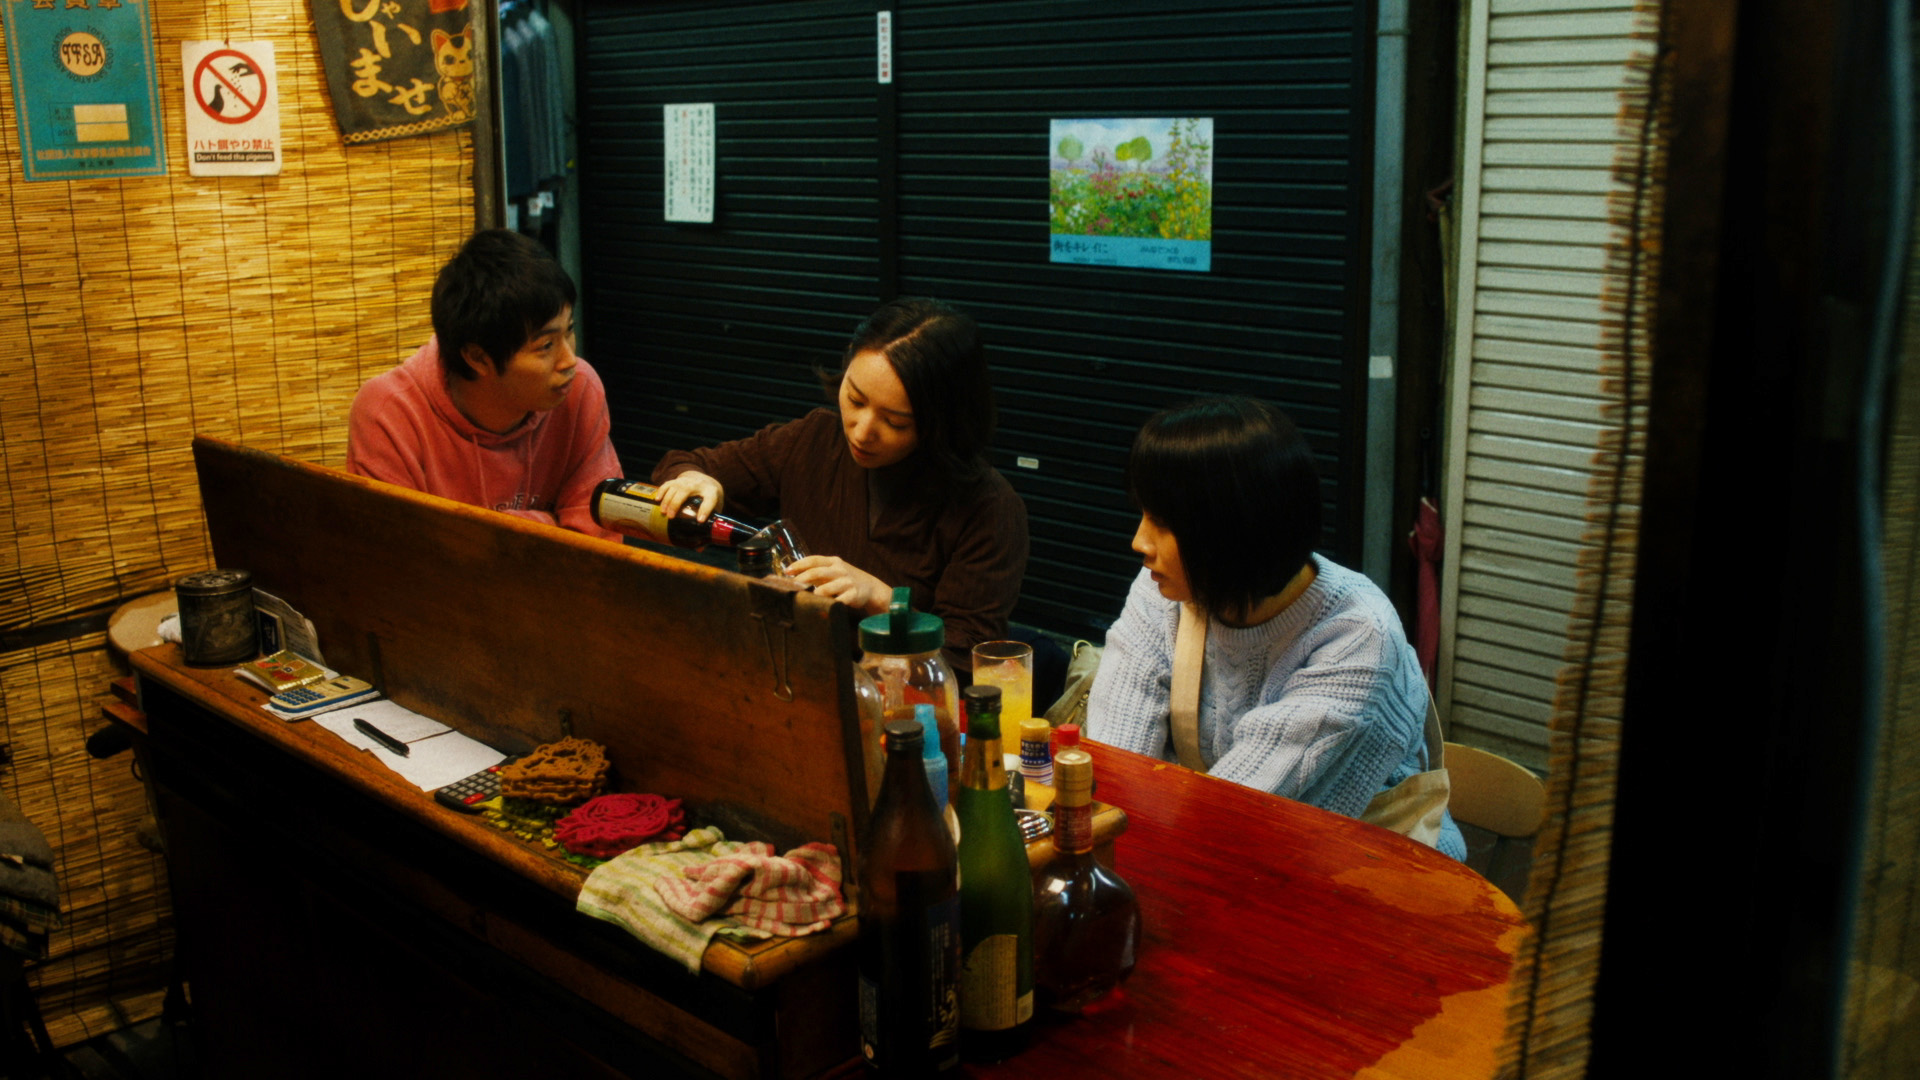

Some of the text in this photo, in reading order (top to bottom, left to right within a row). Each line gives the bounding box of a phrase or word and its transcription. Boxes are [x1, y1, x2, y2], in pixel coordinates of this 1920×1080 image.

[194, 138, 274, 150] ハト餌やり禁止
[196, 153, 216, 161] Don't
[246, 153, 273, 162] pigeons
